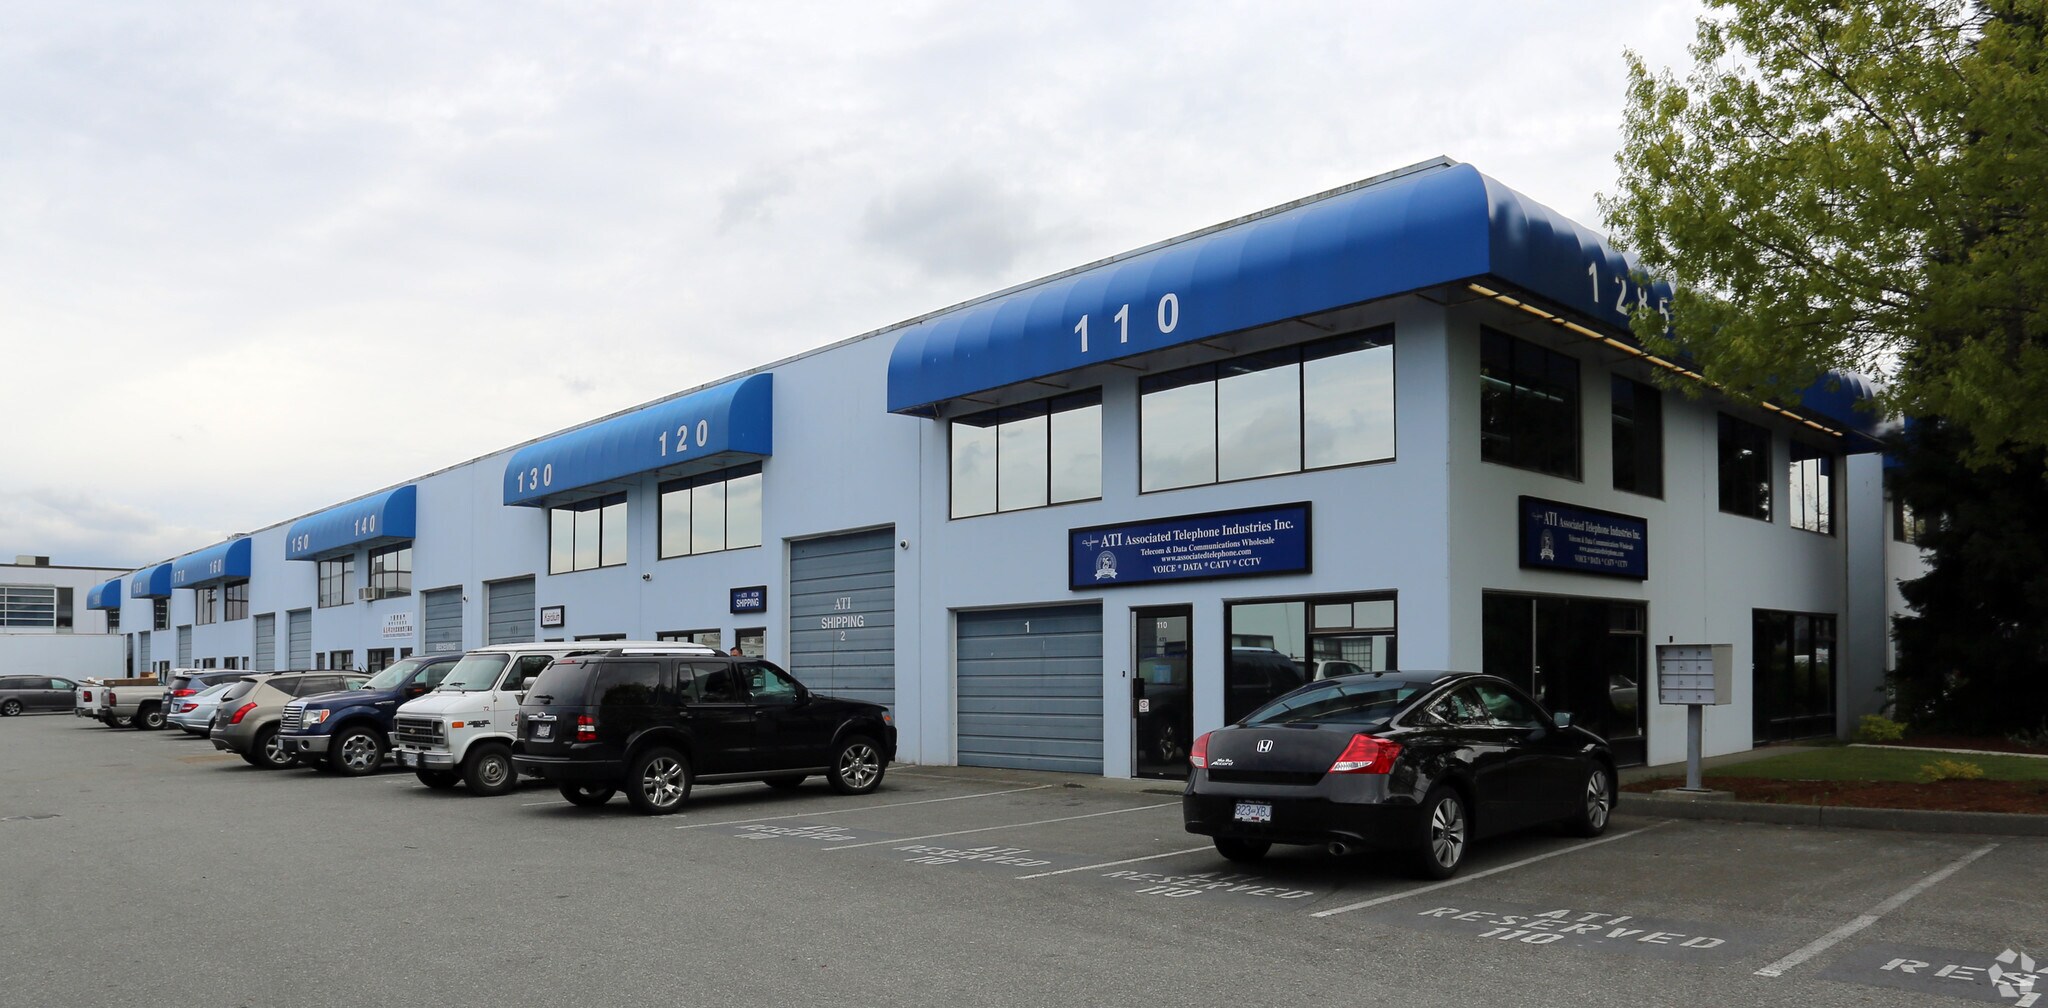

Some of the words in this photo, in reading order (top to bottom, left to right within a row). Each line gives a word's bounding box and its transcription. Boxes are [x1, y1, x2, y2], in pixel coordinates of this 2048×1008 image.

[1588, 261, 1669, 334] 1285
[1074, 293, 1179, 353] 110
[659, 419, 708, 457] 120
[517, 463, 552, 493] 130
[354, 514, 376, 537] 140
[1544, 511, 1558, 526] ATI
[1559, 516, 1585, 531] Associated
[1585, 521, 1610, 535] Telephone
[1101, 533, 1122, 548] ATI
[1125, 530, 1171, 546] Associated
[1173, 528, 1220, 541] Telephone
[1222, 521, 1272, 536] Industries
[1274, 519, 1294, 531] Inc.
[292, 534, 309, 553] 150
[1141, 546, 1165, 556] Telecom
[1166, 545, 1172, 553] &
[1173, 544, 1188, 553] Data
[1189, 540, 1240, 552] Communications
[1242, 536, 1275, 546] Wholesale
[209, 559, 222, 575] 160
[1153, 564, 1177, 574] VOICE
[1183, 562, 1203, 572] DATA
[1210, 559, 1232, 570] CATV
[1238, 557, 1262, 567] CCTV
[174, 570, 185, 583] 170
[736, 598, 760, 608] SHIPPING
[834, 597, 851, 610] ATI
[821, 615, 865, 629] SHIPPING
[1025, 620, 1030, 633] 1
[1157, 621, 1168, 629] 110
[840, 630, 846, 641] 2
[1236, 804, 1251, 815] 823
[735, 824, 857, 841] RESERVED
[892, 845, 1052, 867] RESERVED
[965, 846, 1032, 856] ATI
[903, 856, 960, 865] 110
[1101, 870, 1315, 899] RESERVED
[1135, 885, 1203, 898] 110
[1534, 909, 1633, 926] ATI
[1417, 907, 1726, 949] RESERVED
[1478, 927, 1565, 945] 110
